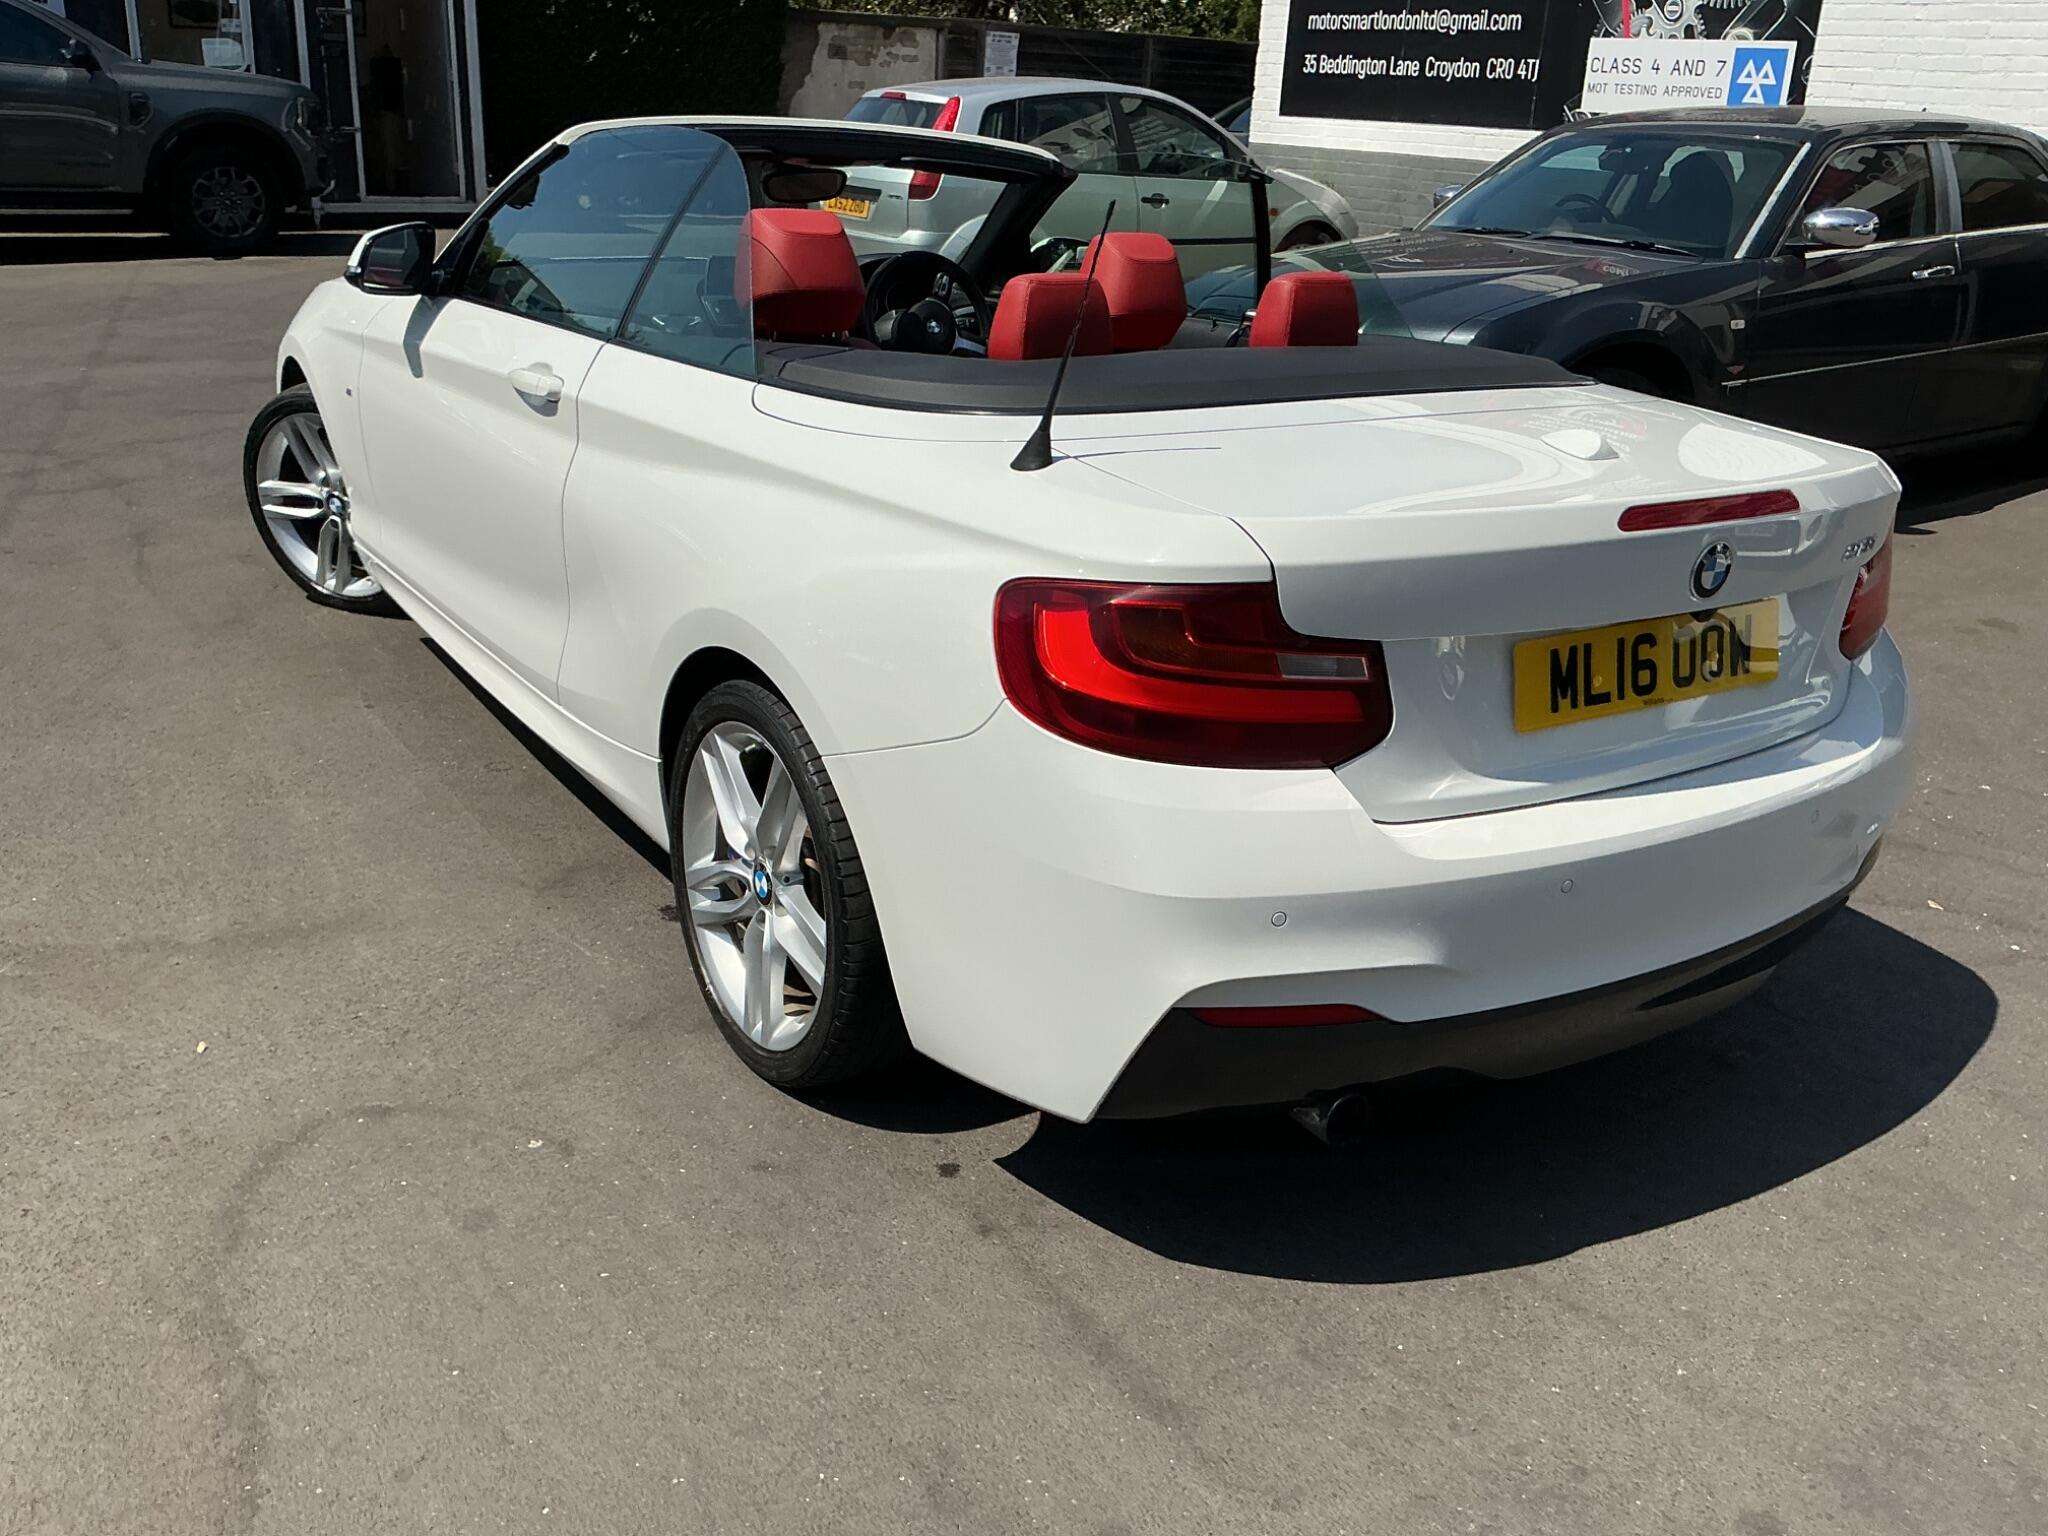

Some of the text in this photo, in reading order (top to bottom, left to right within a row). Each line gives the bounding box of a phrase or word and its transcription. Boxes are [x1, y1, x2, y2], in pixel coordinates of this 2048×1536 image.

[1308, 9, 1521, 35] motorsmartlondonltd@gmail.com
[1303, 54, 1317, 73] 35
[1319, 55, 1387, 79] Beddington
[1390, 56, 1419, 77] Lane
[1425, 56, 1480, 82] Croydon
[1517, 59, 1540, 82] 4TJ
[1590, 57, 1727, 77] CLASS 4 AND 7
[1587, 82, 1723, 99] MOT TESTING APPROVED
[1550, 632, 1658, 713] ML16
